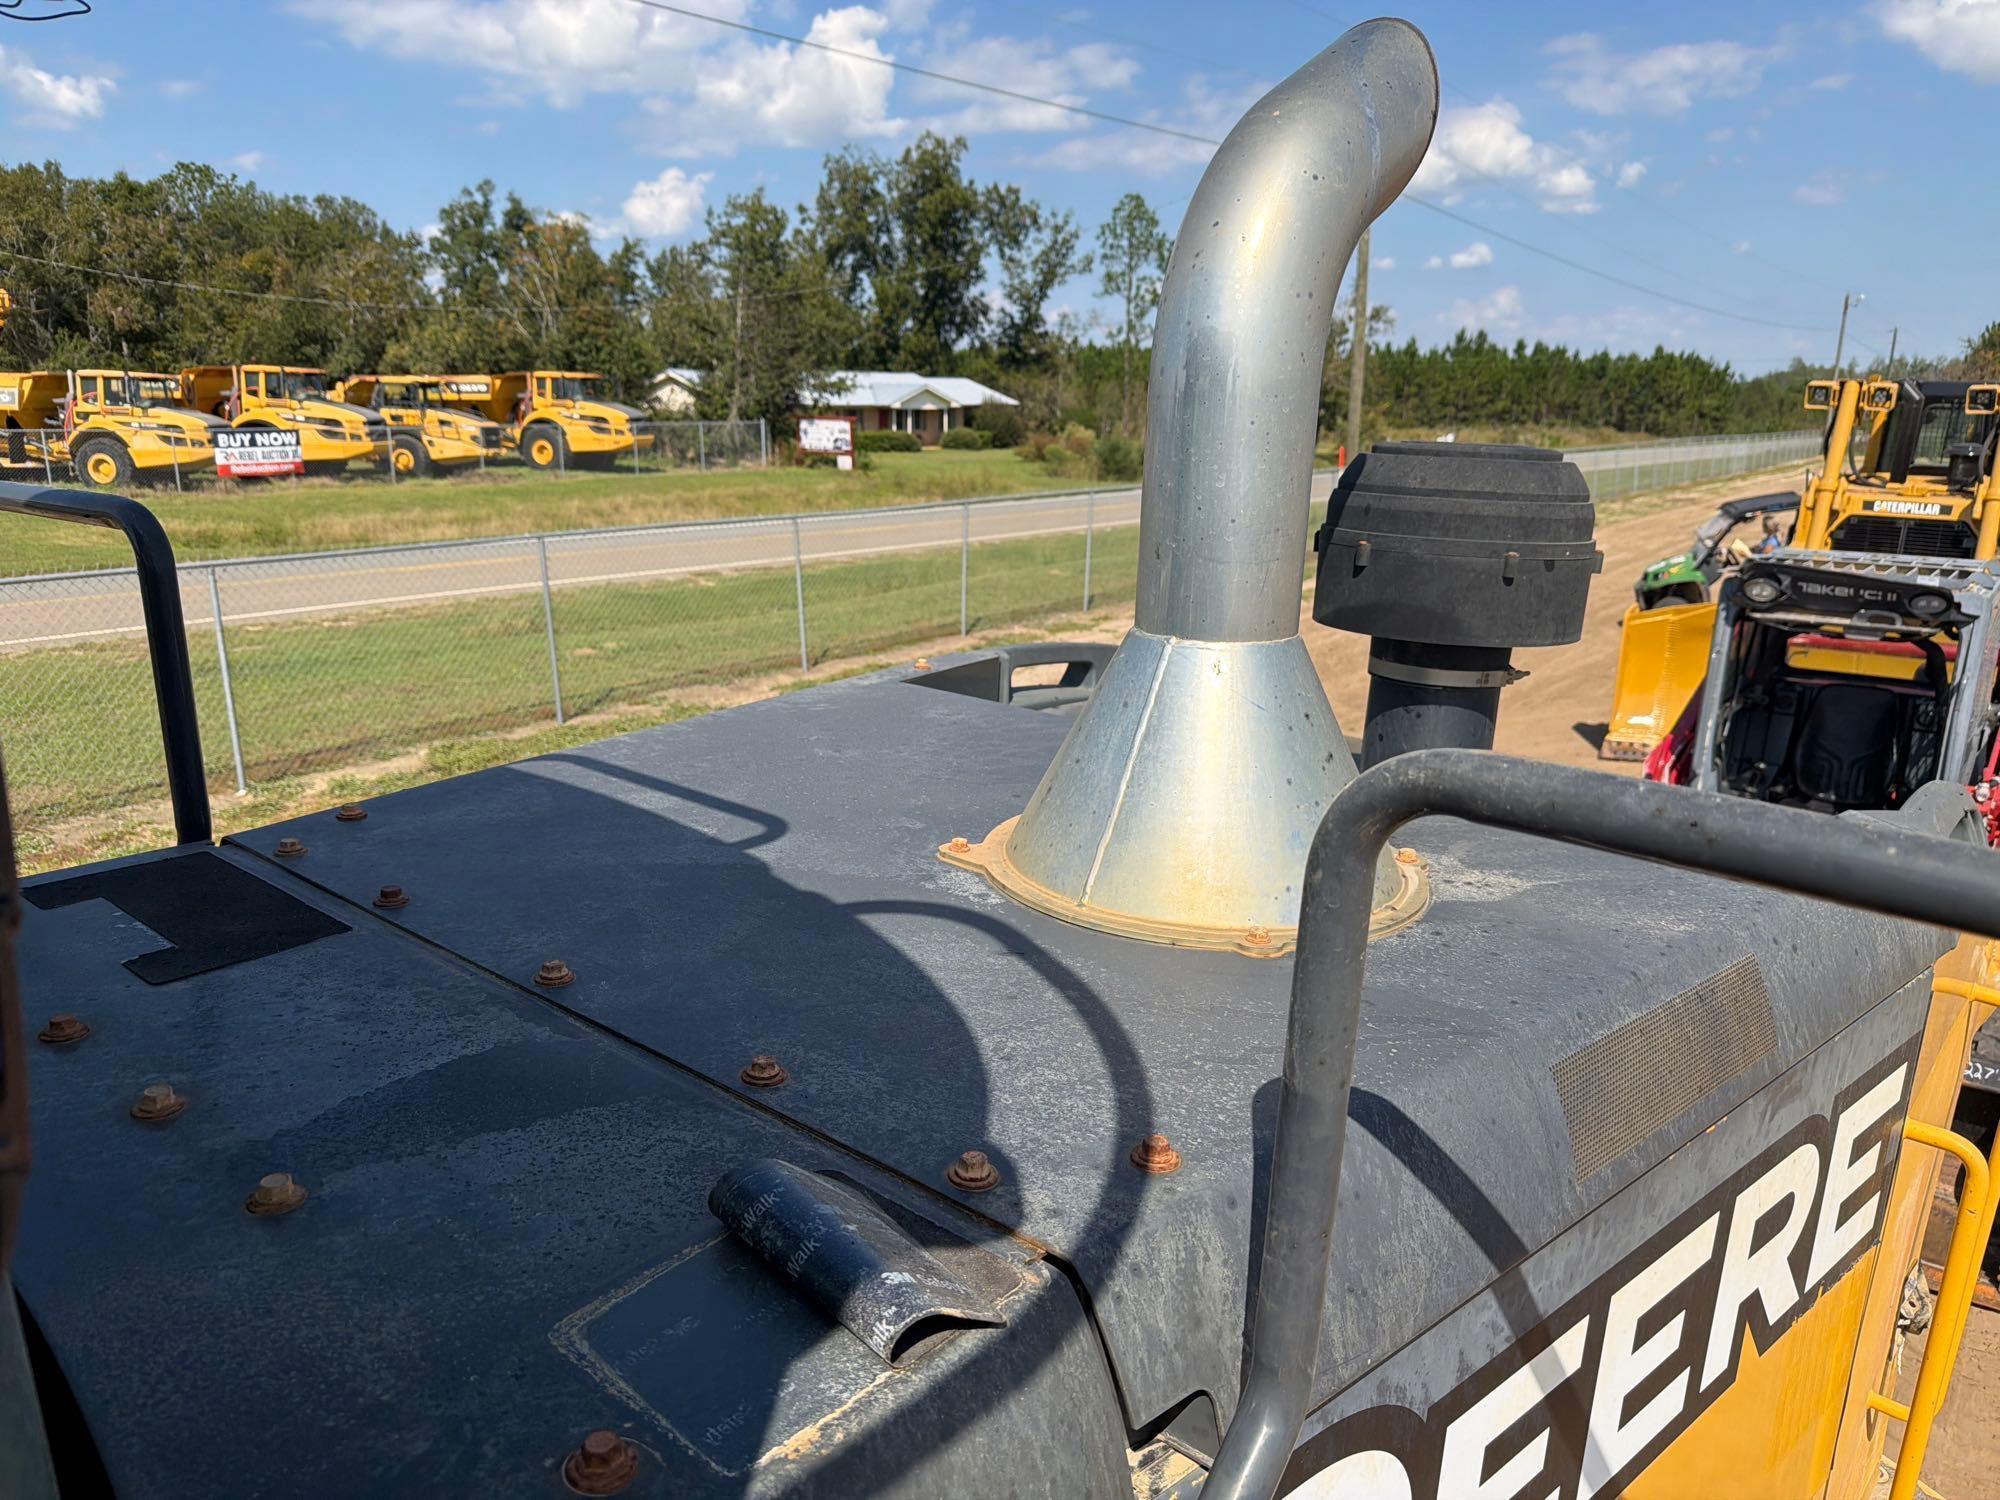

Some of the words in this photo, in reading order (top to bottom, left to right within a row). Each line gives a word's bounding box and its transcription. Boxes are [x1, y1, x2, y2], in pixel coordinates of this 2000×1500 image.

[217, 432, 252, 448] BUY
[255, 430, 298, 447] NOW
[1873, 500, 1941, 516] CATERPILLAR
